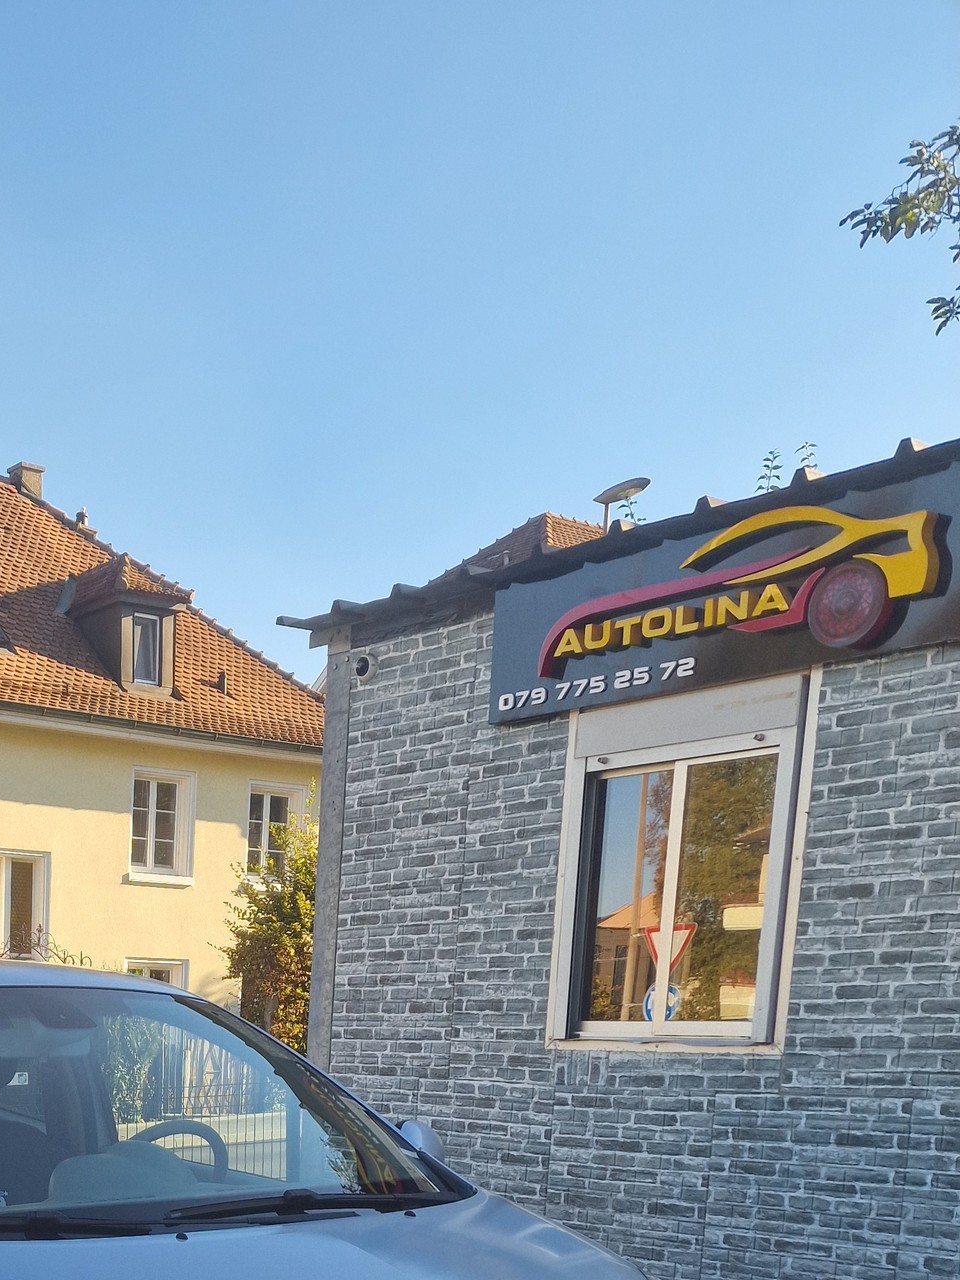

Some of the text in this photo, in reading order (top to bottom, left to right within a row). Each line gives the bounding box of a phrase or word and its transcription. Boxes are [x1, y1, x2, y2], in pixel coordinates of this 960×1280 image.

[553, 583, 790, 658] AUTOLINA
[498, 657, 696, 711] 079 775 25 72
